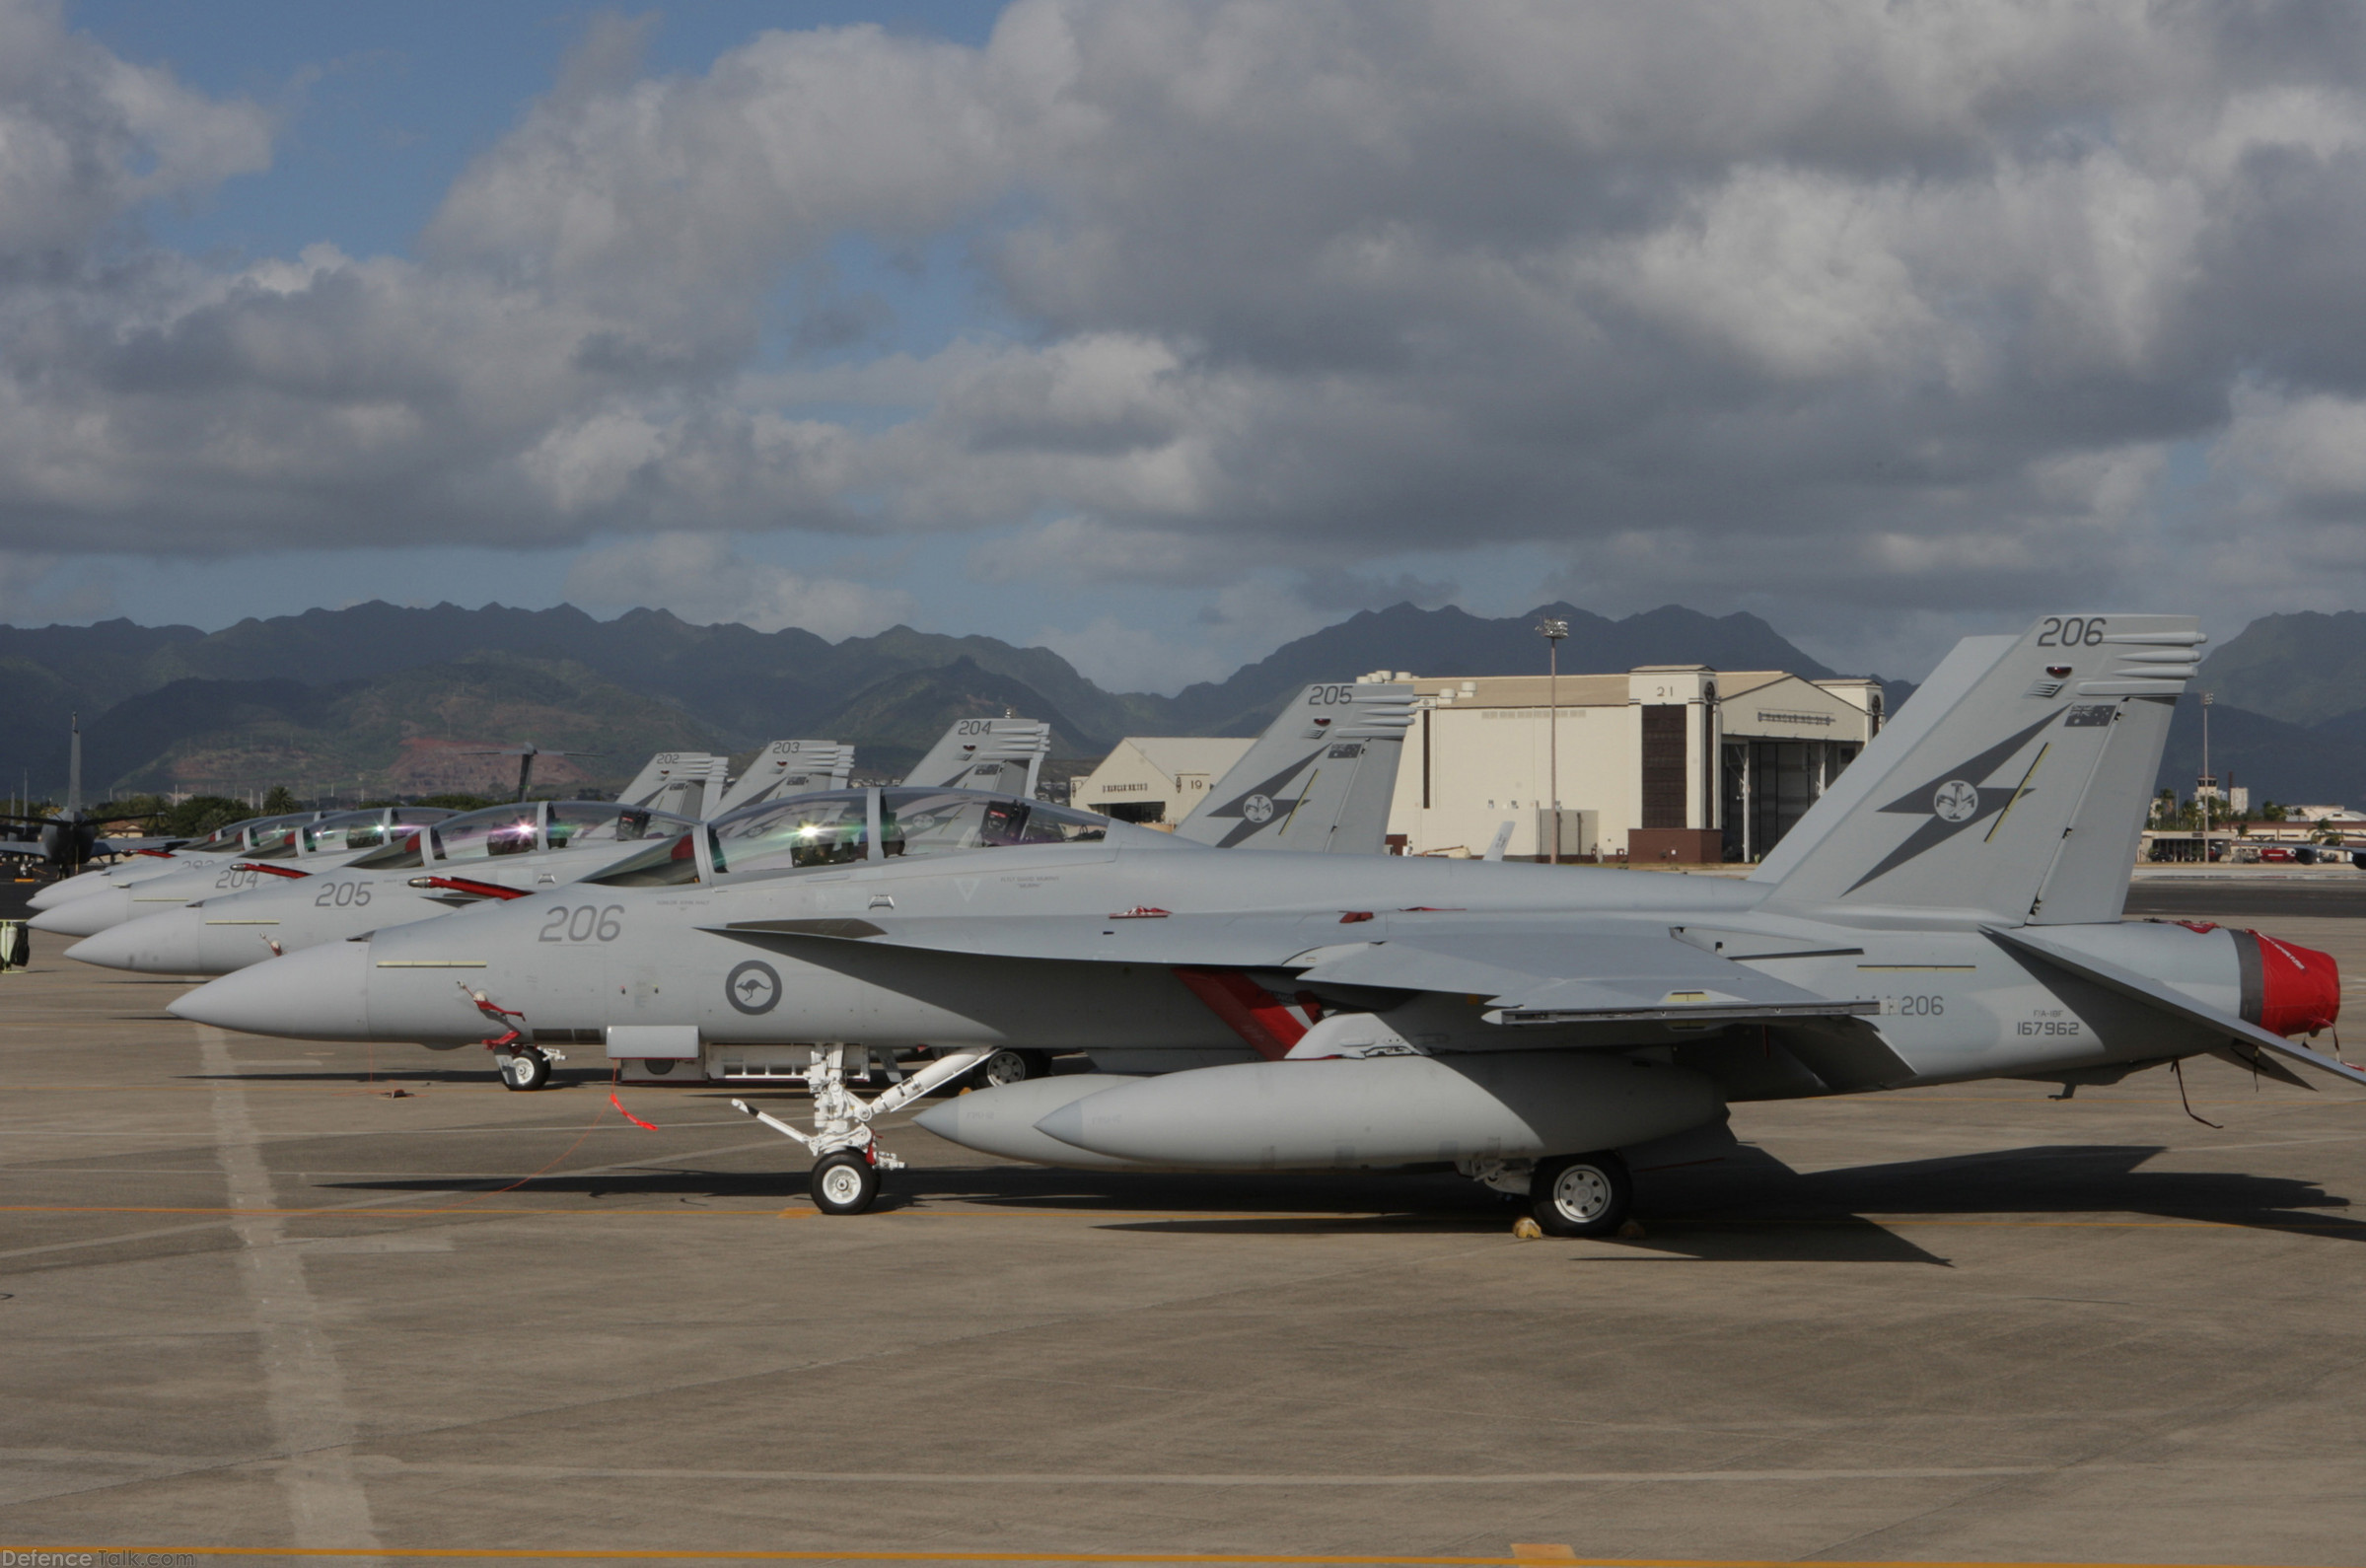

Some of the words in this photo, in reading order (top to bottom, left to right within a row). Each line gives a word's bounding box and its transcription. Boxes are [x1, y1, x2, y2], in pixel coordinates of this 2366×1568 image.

[2037, 617, 2107, 647] 206
[1309, 684, 1353, 705] 205
[1657, 685, 1673, 697] 21
[958, 720, 992, 735] 204
[772, 742, 801, 753] 203
[656, 753, 680, 764] 202
[1190, 780, 1203, 790] 19
[215, 870, 258, 889] 204
[315, 882, 372, 906] 205
[538, 904, 624, 942] 206
[1901, 995, 1945, 1016] 206
[2017, 1021, 2080, 1035] 167962
